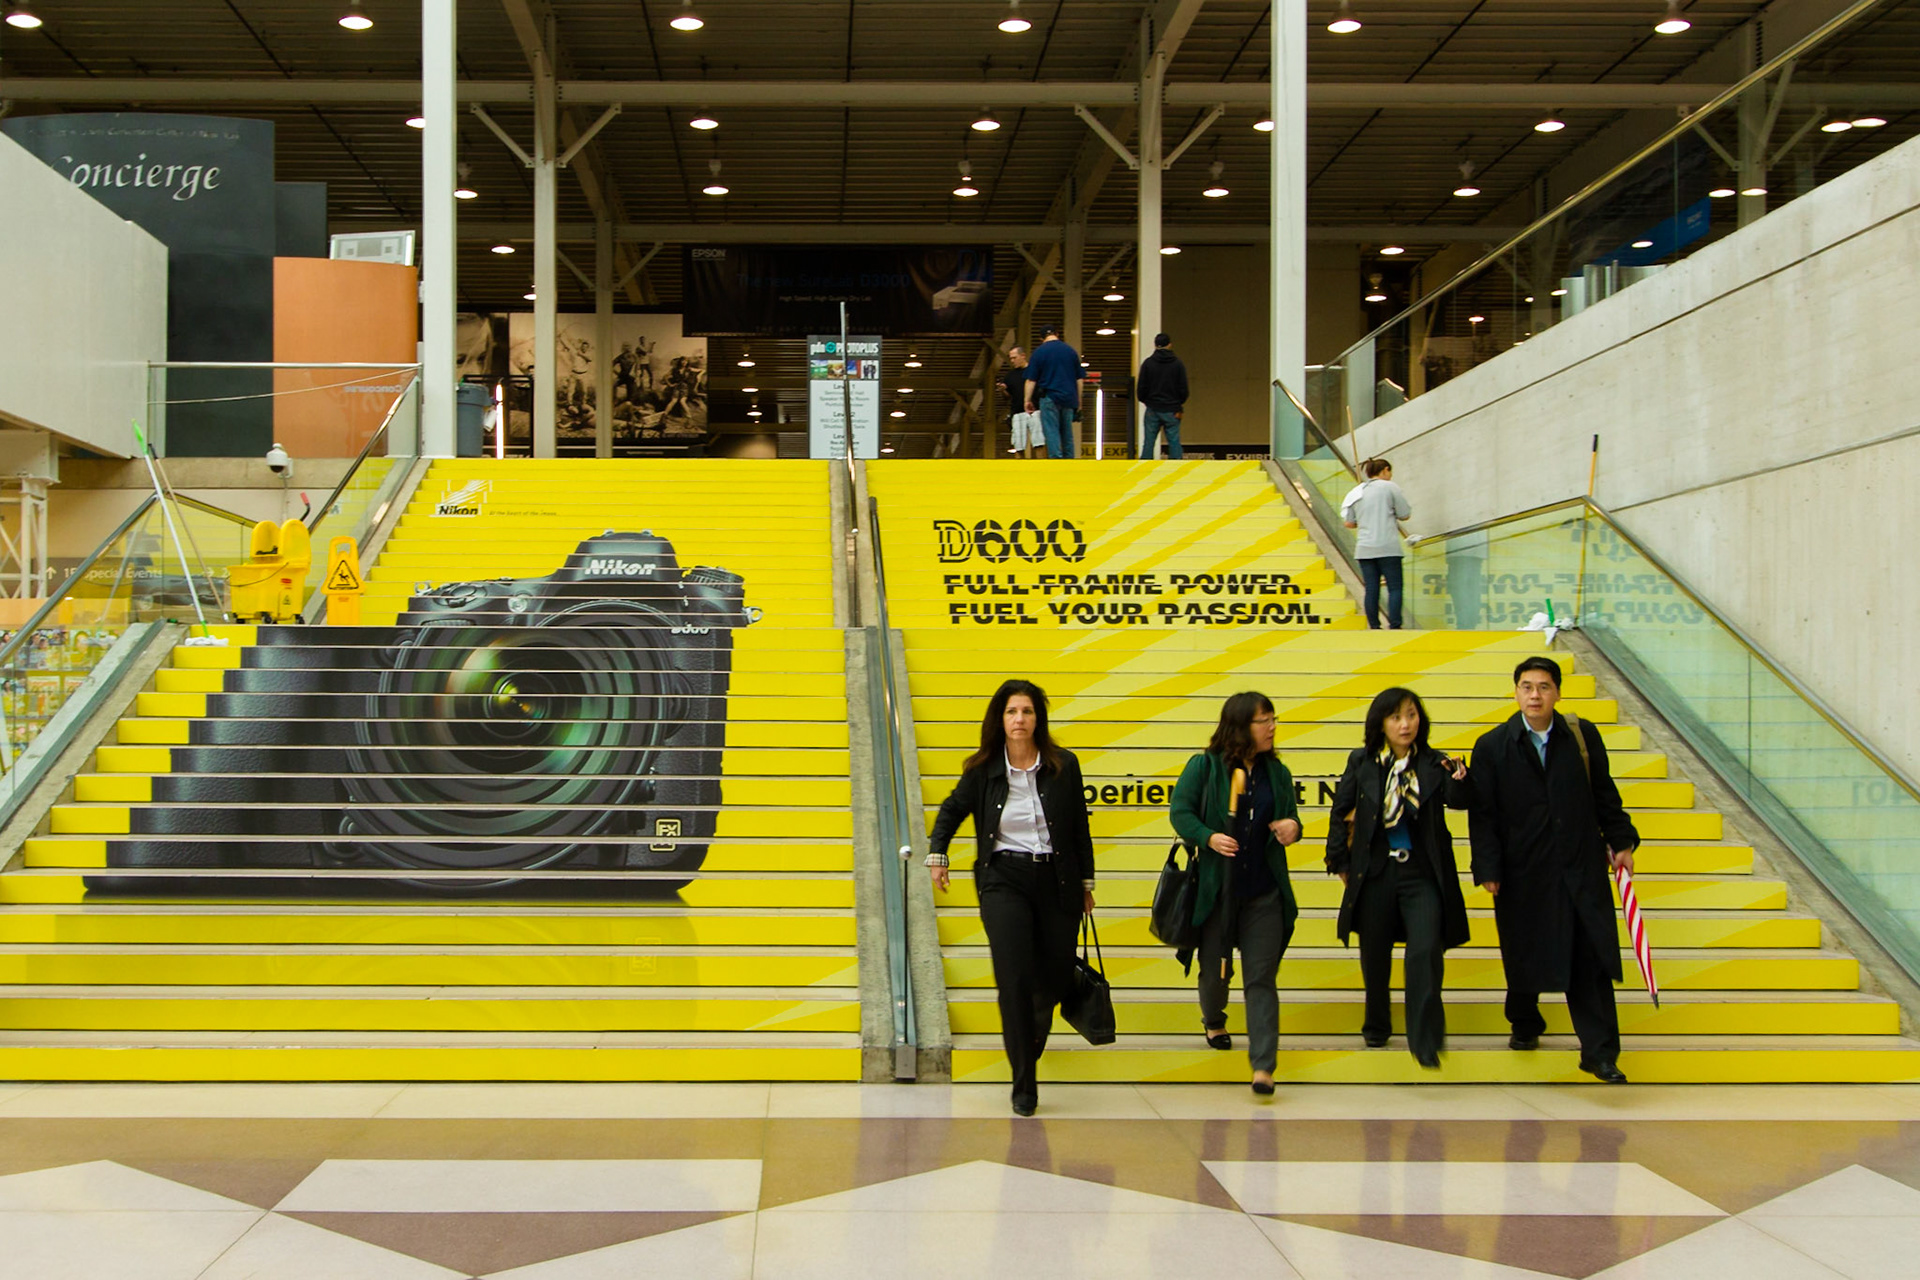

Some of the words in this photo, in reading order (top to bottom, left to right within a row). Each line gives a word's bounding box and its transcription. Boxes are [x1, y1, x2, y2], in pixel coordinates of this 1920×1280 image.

[691, 248, 727, 258] EPSON
[438, 505, 479, 516] Nikon
[933, 519, 1087, 563] D600
[126, 567, 163, 578] Events
[585, 558, 657, 576] Nikon
[944, 574, 1163, 595] FULL-FRAME
[1170, 574, 1312, 595] POWER.
[949, 603, 1039, 625] FUEL
[1047, 603, 1149, 625] YOUR
[1158, 603, 1332, 625] PASSION.
